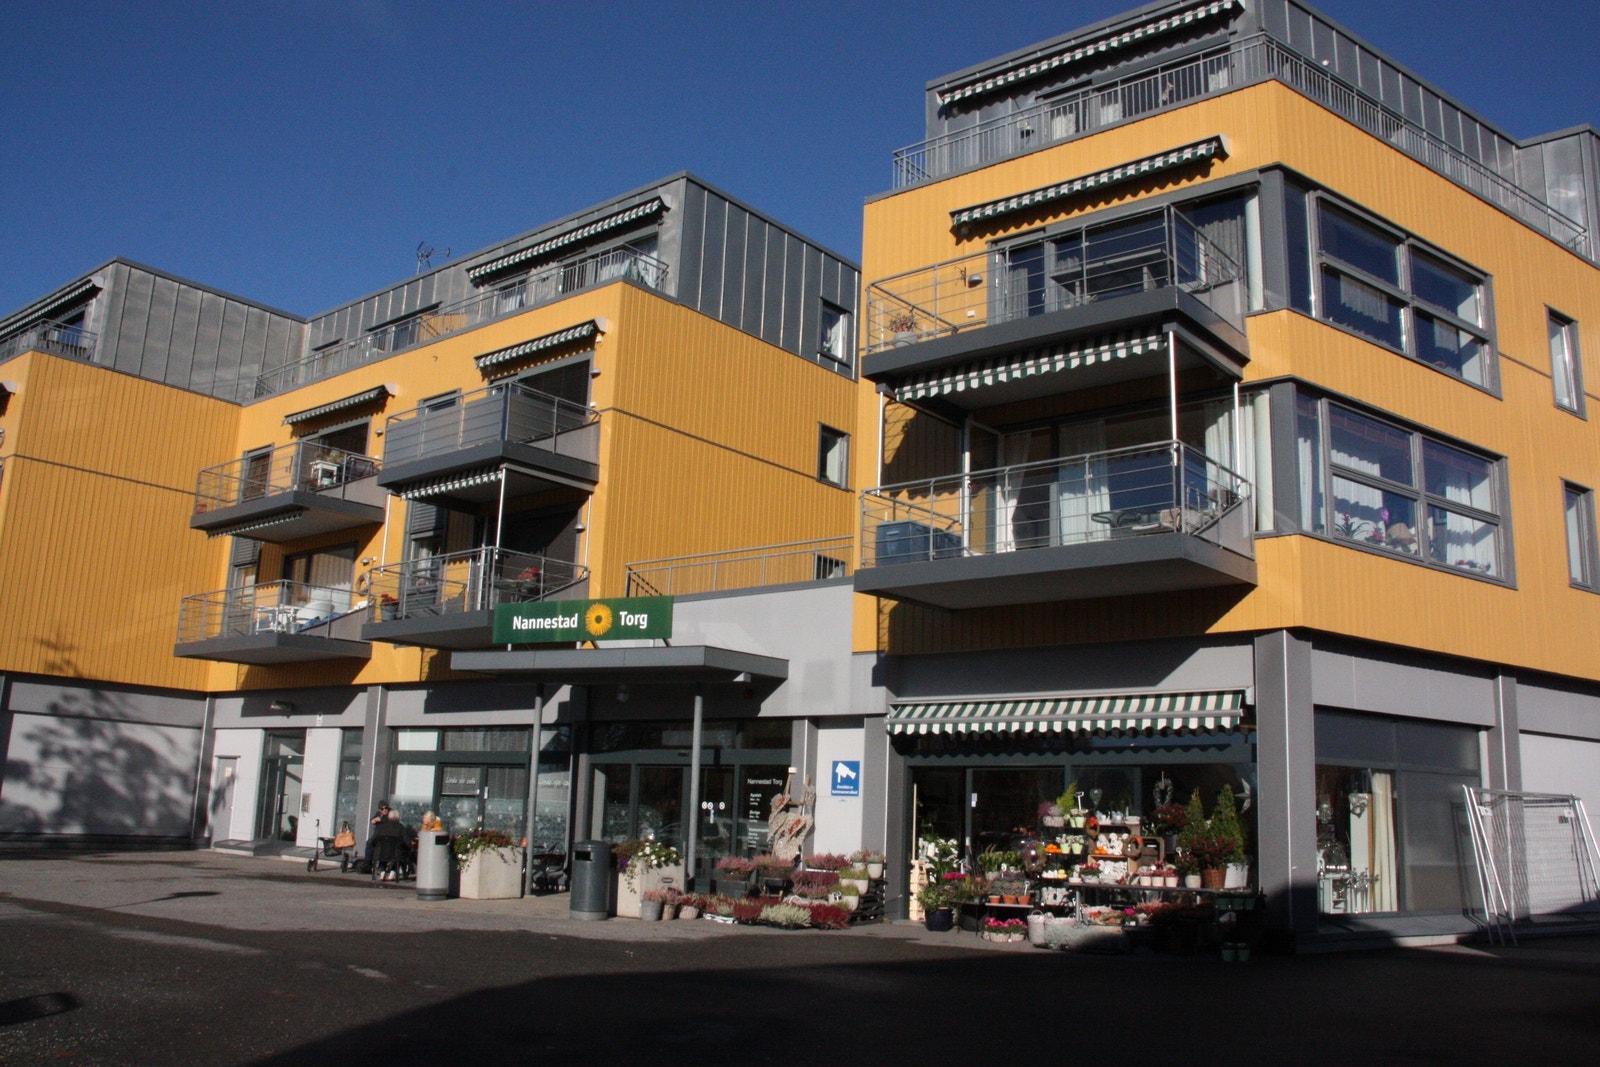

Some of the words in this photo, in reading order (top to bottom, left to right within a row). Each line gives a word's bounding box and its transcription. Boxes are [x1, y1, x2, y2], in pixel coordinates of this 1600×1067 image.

[512, 613, 578, 630] Nannestad
[619, 611, 648, 629] Torg
[772, 778, 782, 786] Torg
